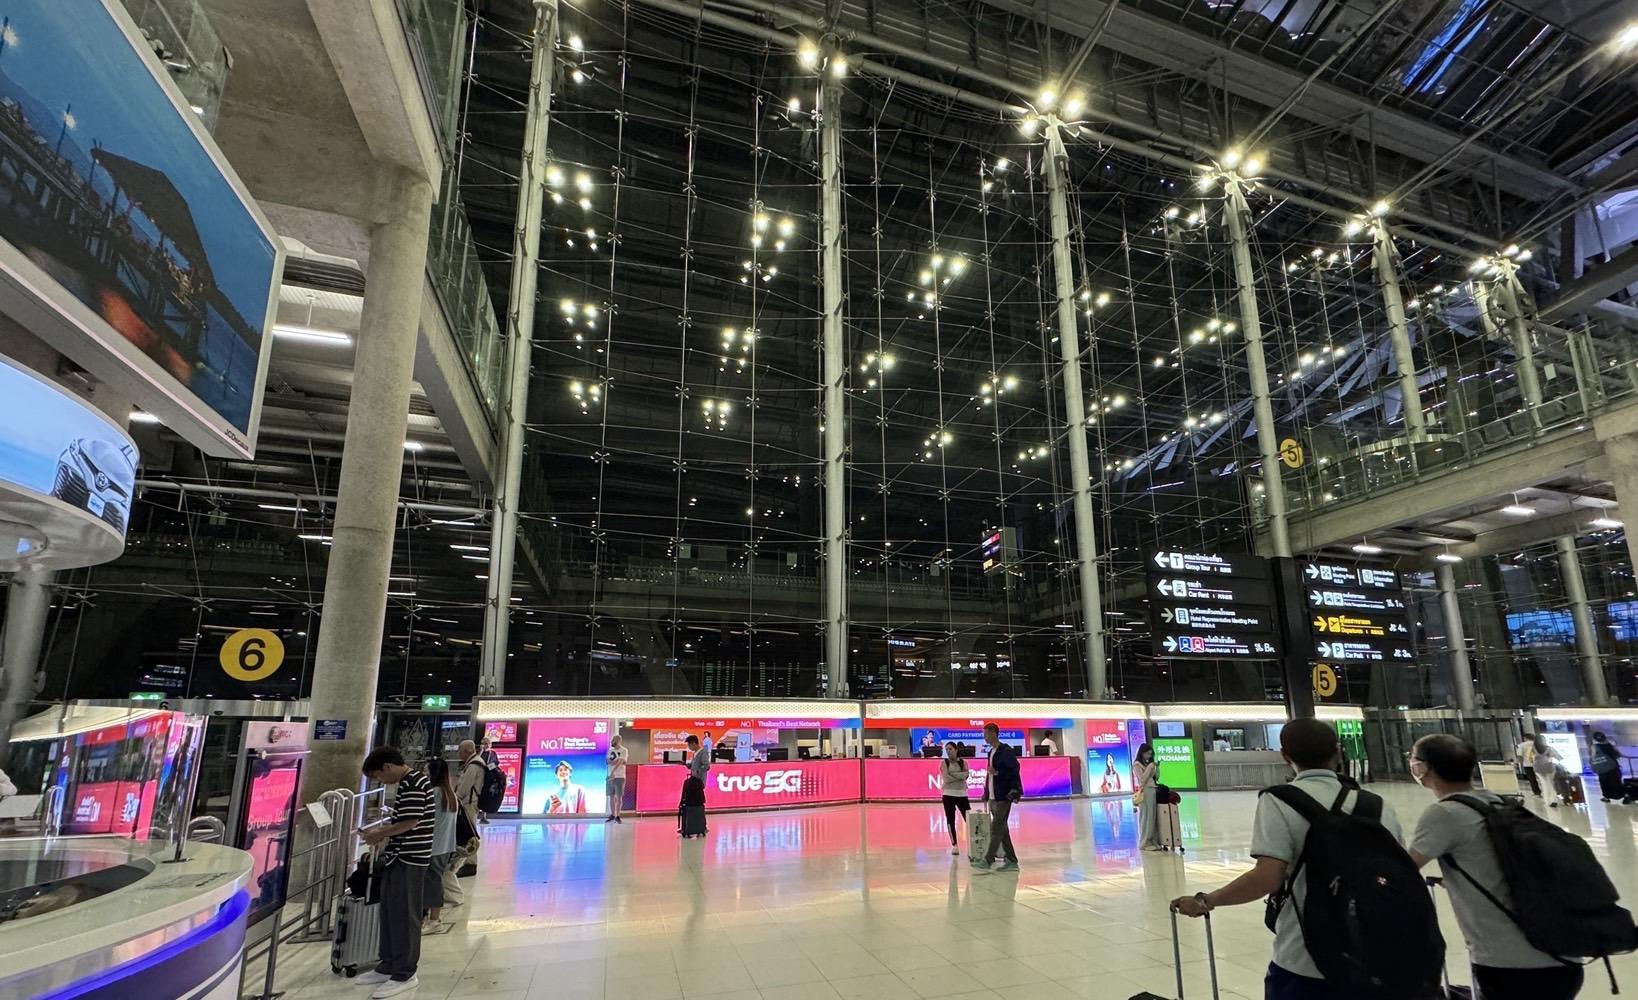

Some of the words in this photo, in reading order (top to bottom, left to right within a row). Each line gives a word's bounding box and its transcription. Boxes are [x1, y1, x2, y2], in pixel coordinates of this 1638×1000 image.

[239, 638, 266, 671] 6
[1320, 671, 1331, 690] 5
[758, 721, 784, 729] Thailand's
[541, 737, 564, 750] NO.1
[717, 772, 762, 792] true
[763, 769, 802, 794] 5G
[928, 774, 944, 790] N
